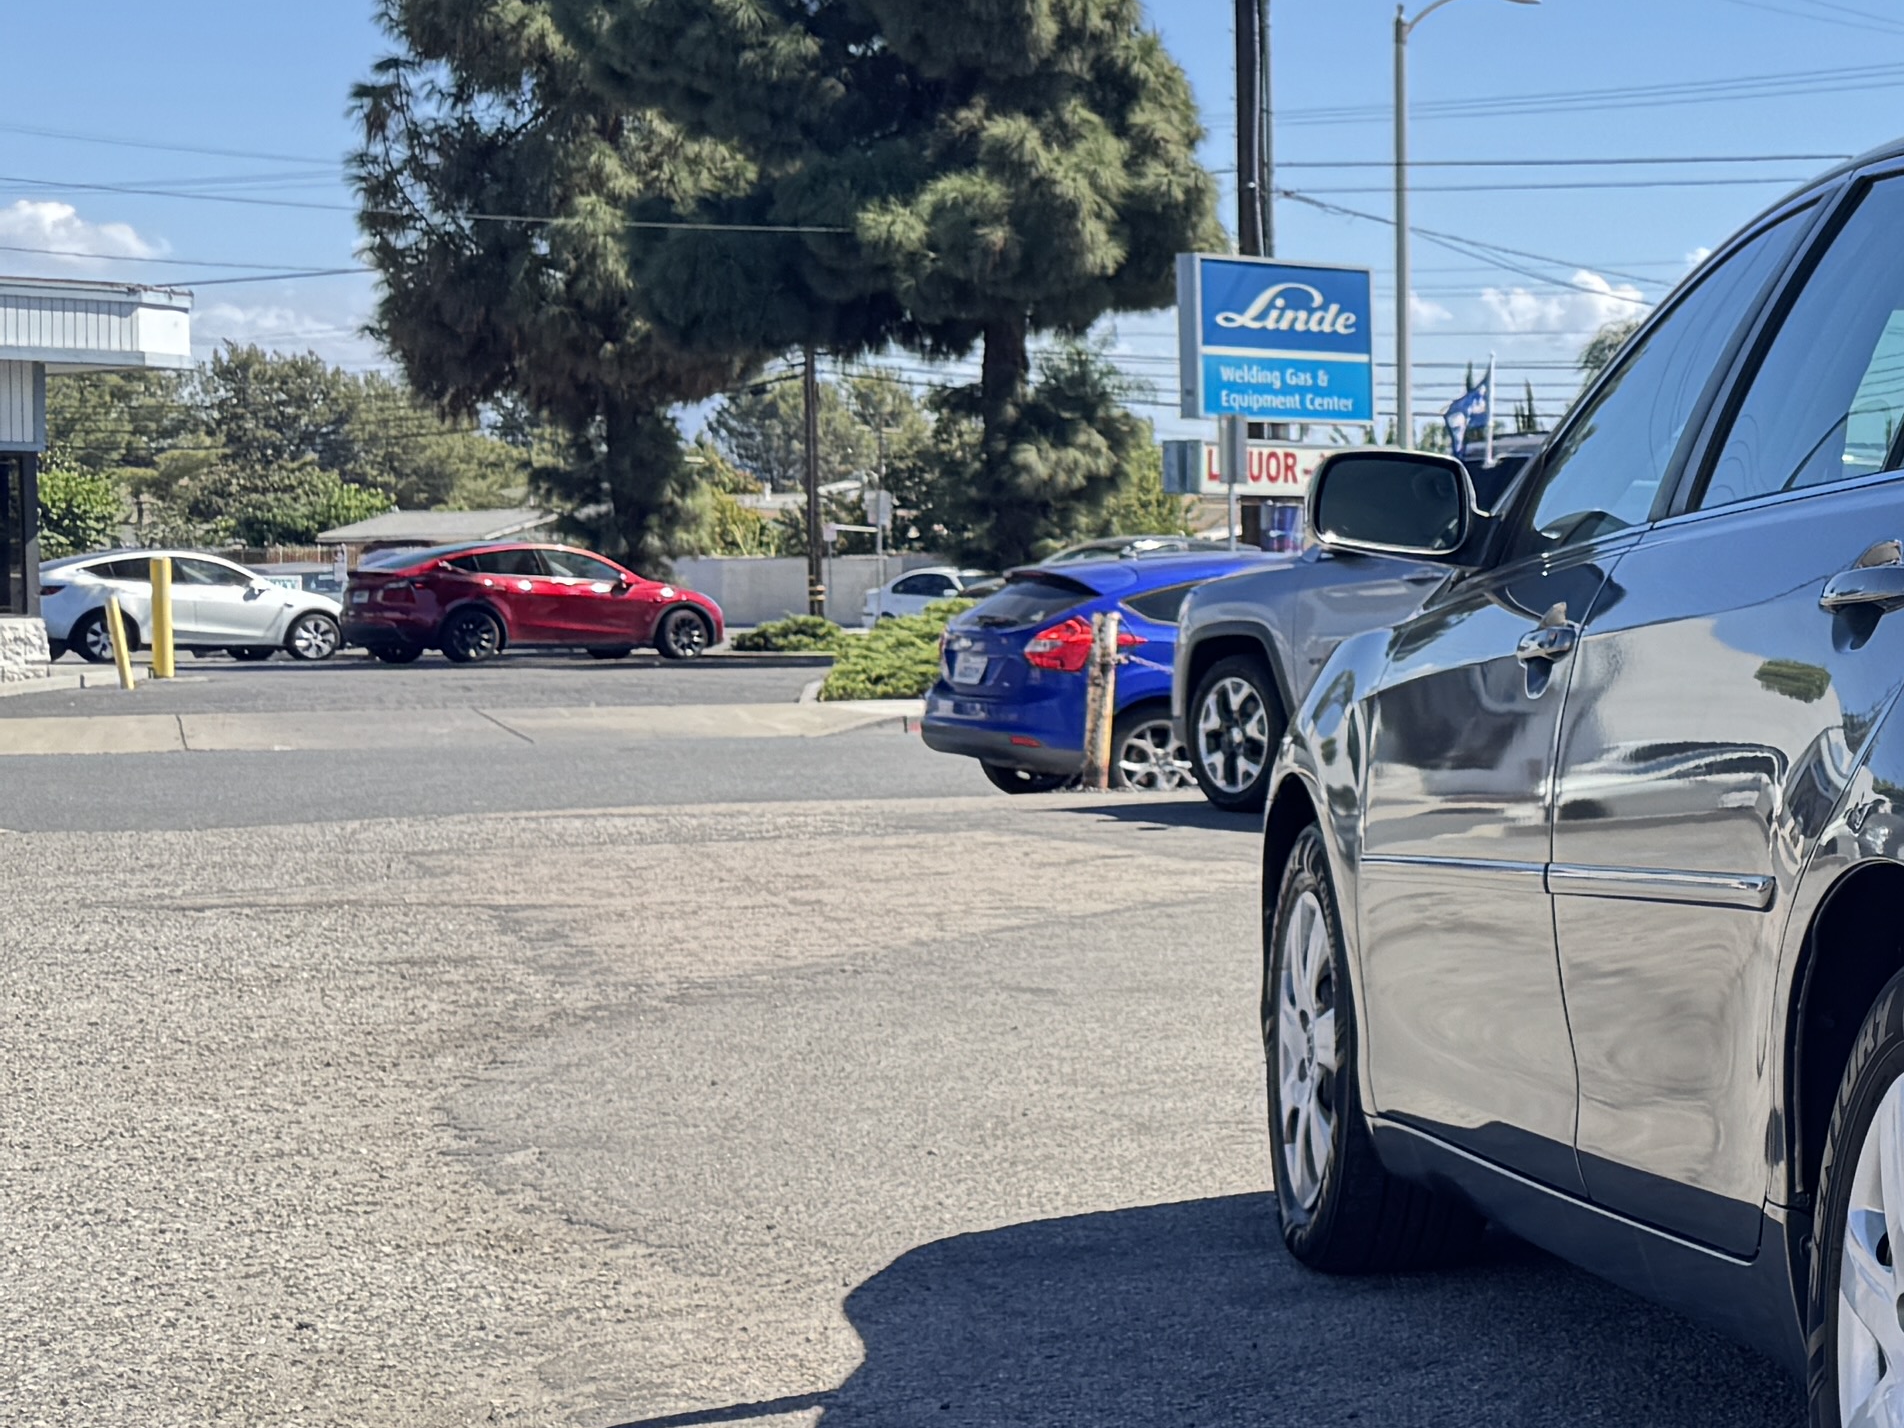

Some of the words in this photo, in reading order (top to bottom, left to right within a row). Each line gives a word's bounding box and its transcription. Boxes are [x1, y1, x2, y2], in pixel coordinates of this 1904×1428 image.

[1215, 282, 1357, 335] Linde
[1219, 364, 1281, 389] Welding
[1286, 368, 1313, 386] Gas
[1317, 369, 1329, 387] &
[1221, 389, 1301, 412] Equipment
[1305, 394, 1354, 411] Center
[1207, 448, 1298, 484] LUOR
